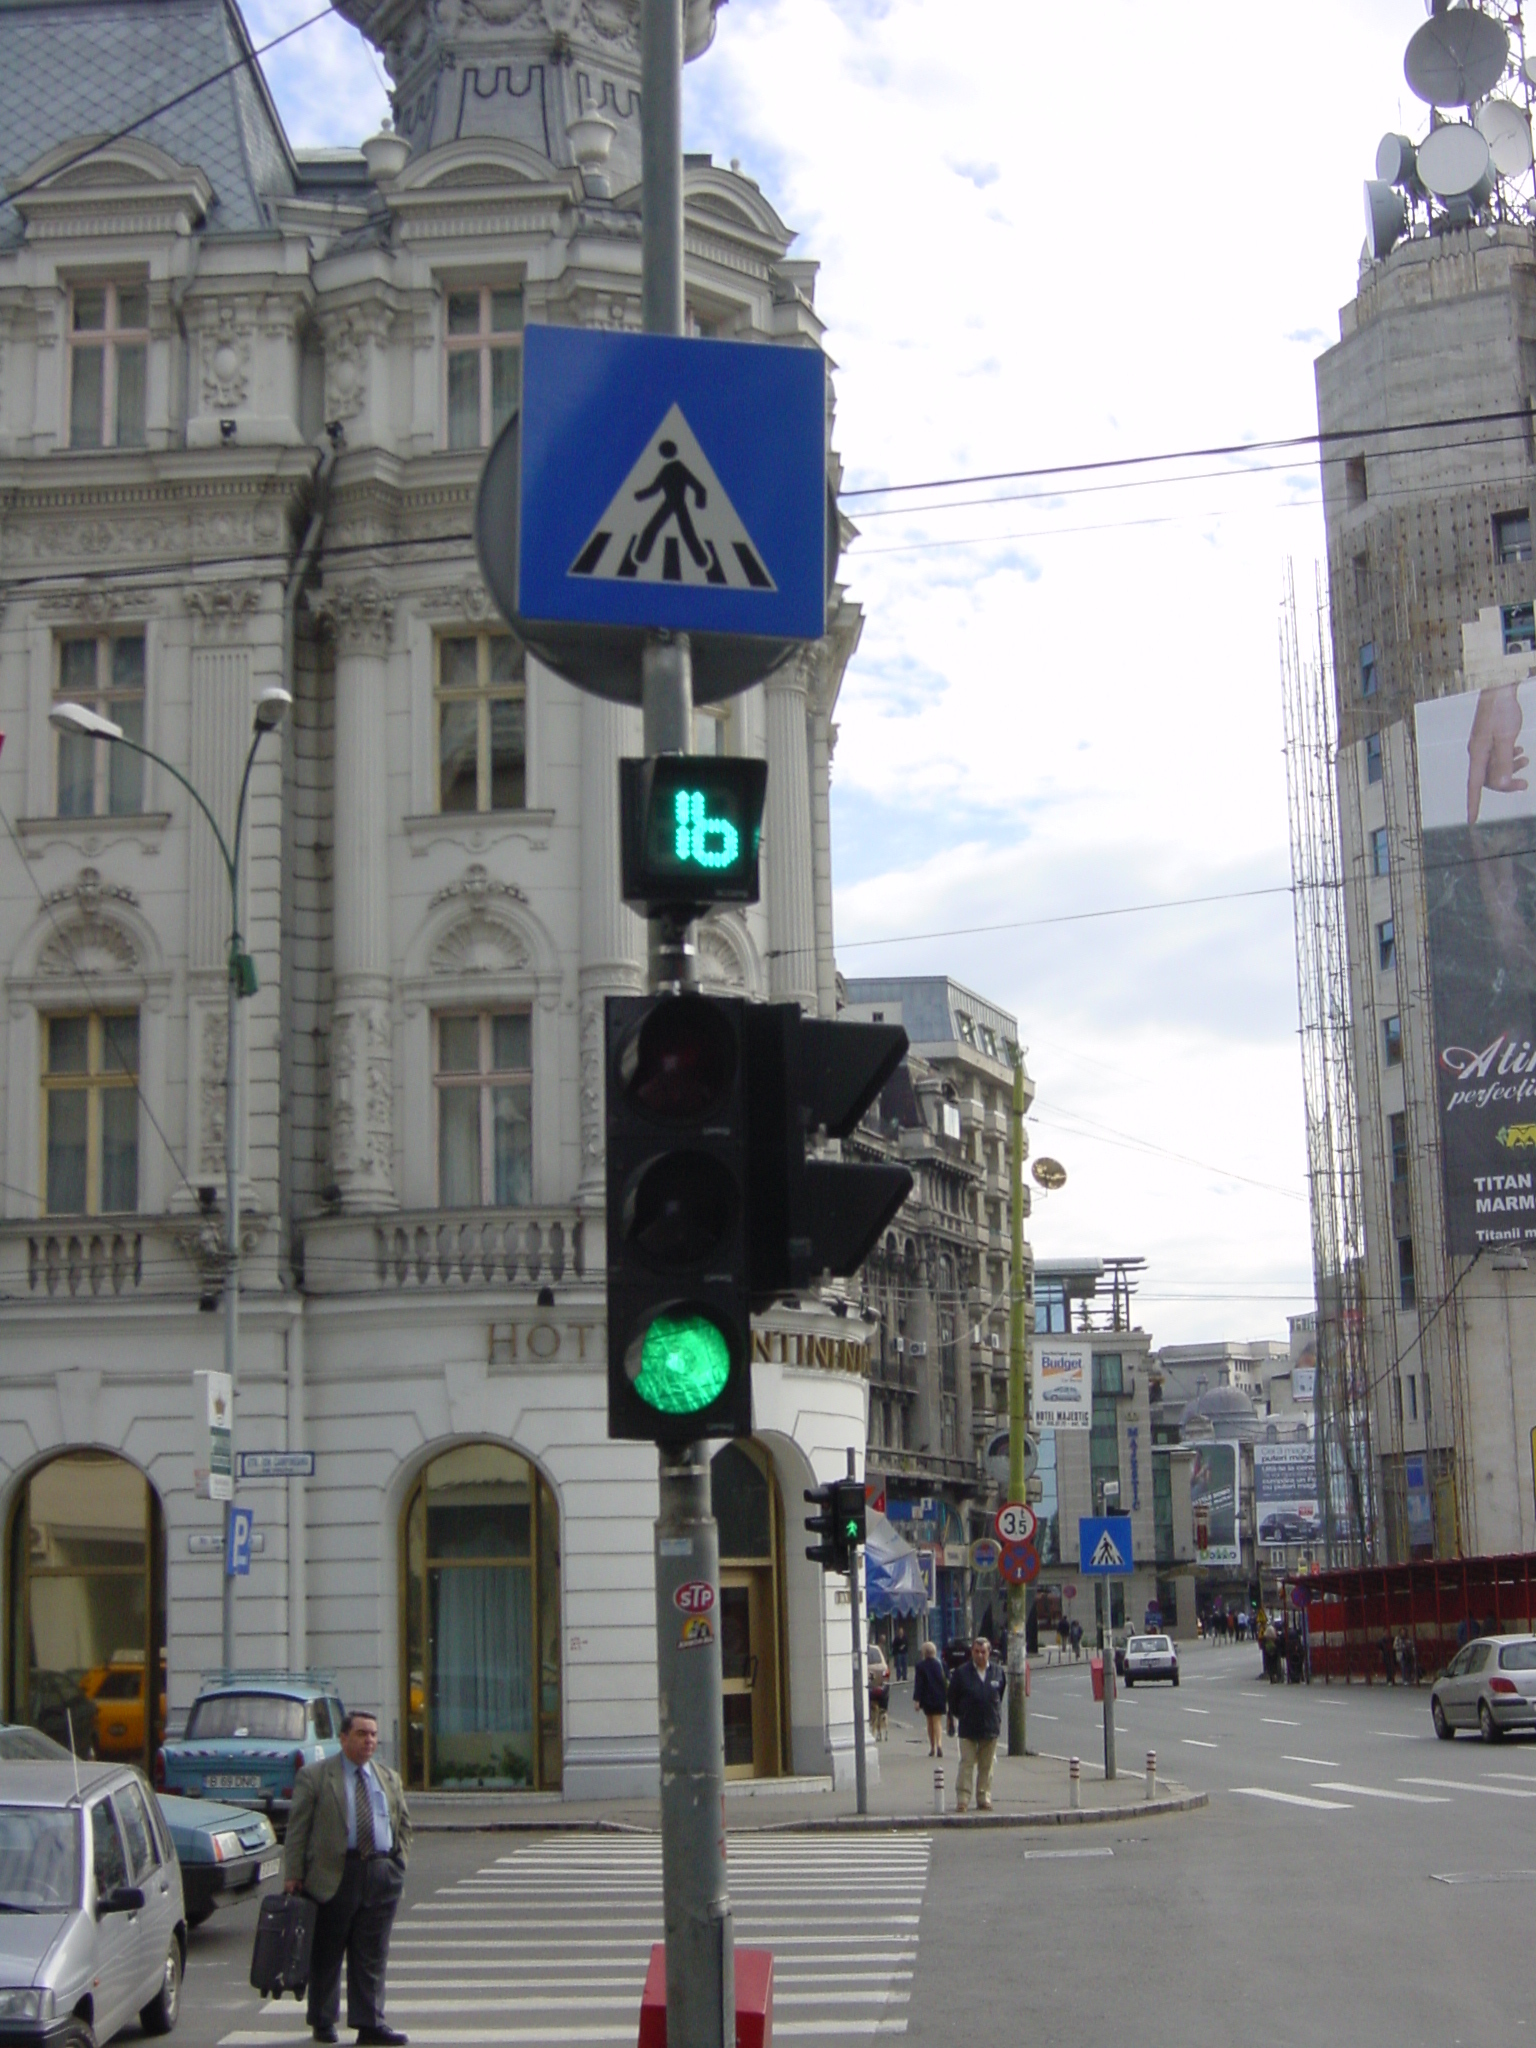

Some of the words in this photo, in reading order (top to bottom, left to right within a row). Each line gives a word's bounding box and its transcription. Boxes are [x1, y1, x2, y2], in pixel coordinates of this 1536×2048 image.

[674, 789, 739, 868] 16
[1473, 1173, 1532, 1192] TITAN
[1476, 1195, 1536, 1213] MARM
[488, 1323, 600, 1358] HOT
[1042, 1356, 1082, 1372] Budget
[1036, 1411, 1055, 1421] HOTEL
[1057, 1411, 1089, 1421] MAJESTIC
[233, 1515, 249, 1567] P
[681, 1585, 712, 1608] STP
